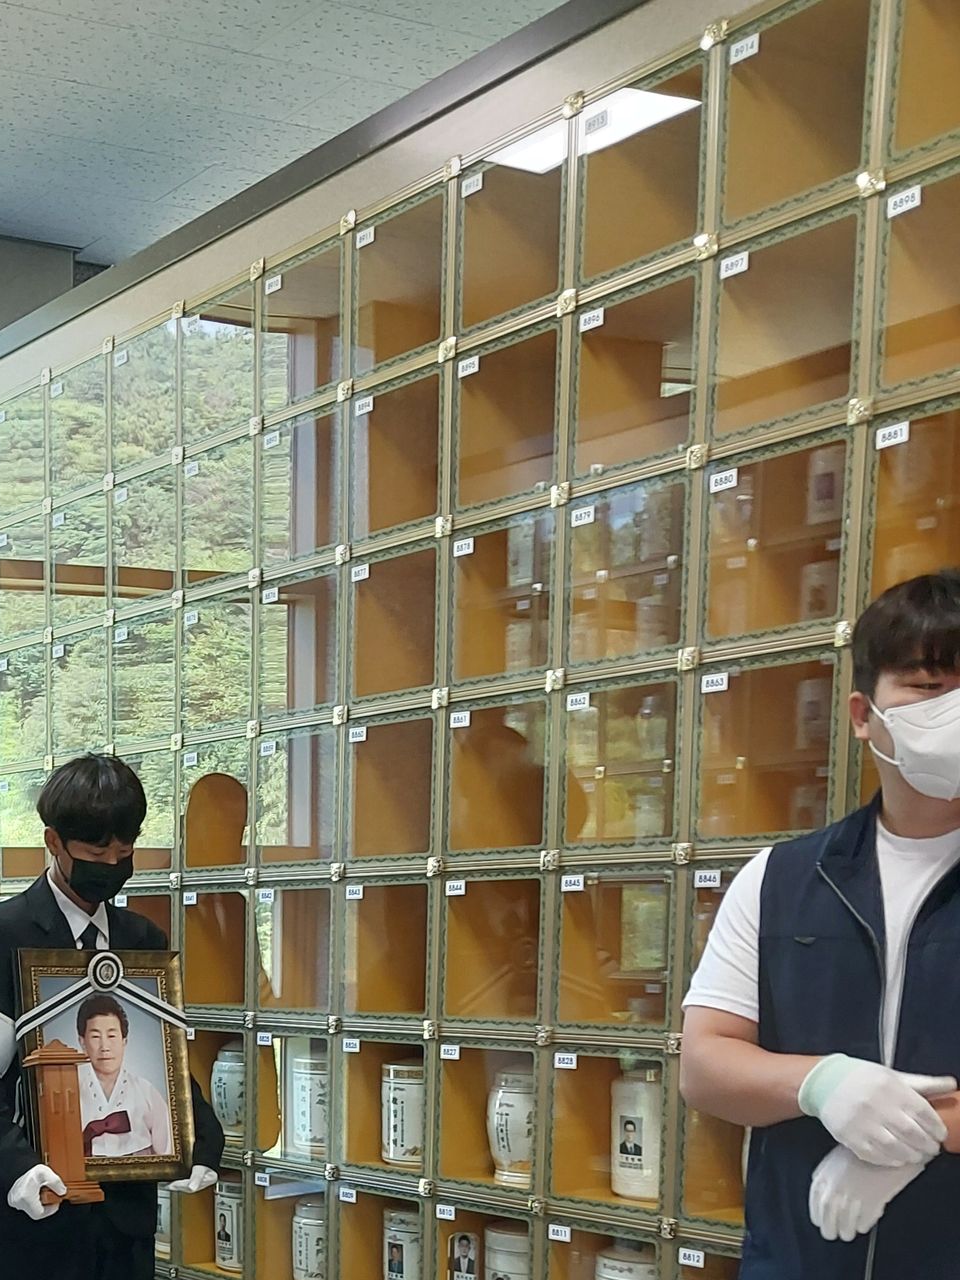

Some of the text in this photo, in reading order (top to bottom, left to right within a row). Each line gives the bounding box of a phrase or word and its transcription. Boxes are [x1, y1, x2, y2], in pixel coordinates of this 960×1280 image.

[734, 40, 755, 58] 8914
[587, 115, 605, 131] 8913
[892, 192, 916, 210] 8898
[359, 231, 372, 244] 8911
[725, 258, 744, 273] 8897
[583, 314, 600, 327] 8896
[461, 361, 476, 372] 8895
[358, 402, 371, 412] 8894
[880, 428, 903, 442] 8881
[714, 474, 734, 487] 8880
[574, 510, 591, 522] 8879
[456, 541, 471, 552] 8878
[705, 677, 724, 688] 8863
[570, 697, 586, 707] 8862
[452, 715, 468, 724] 8861
[564, 878, 581, 888] 8845
[698, 874, 717, 884] 8846
[348, 888, 361, 896] 8843
[448, 884, 462, 892] 8844
[344, 1042, 358, 1050] 8826
[443, 1048, 457, 1056] 8827
[557, 1056, 574, 1065] 8828
[438, 1207, 453, 1217] 8810
[551, 1228, 567, 1238] 8811
[682, 1252, 701, 1263] 8812
